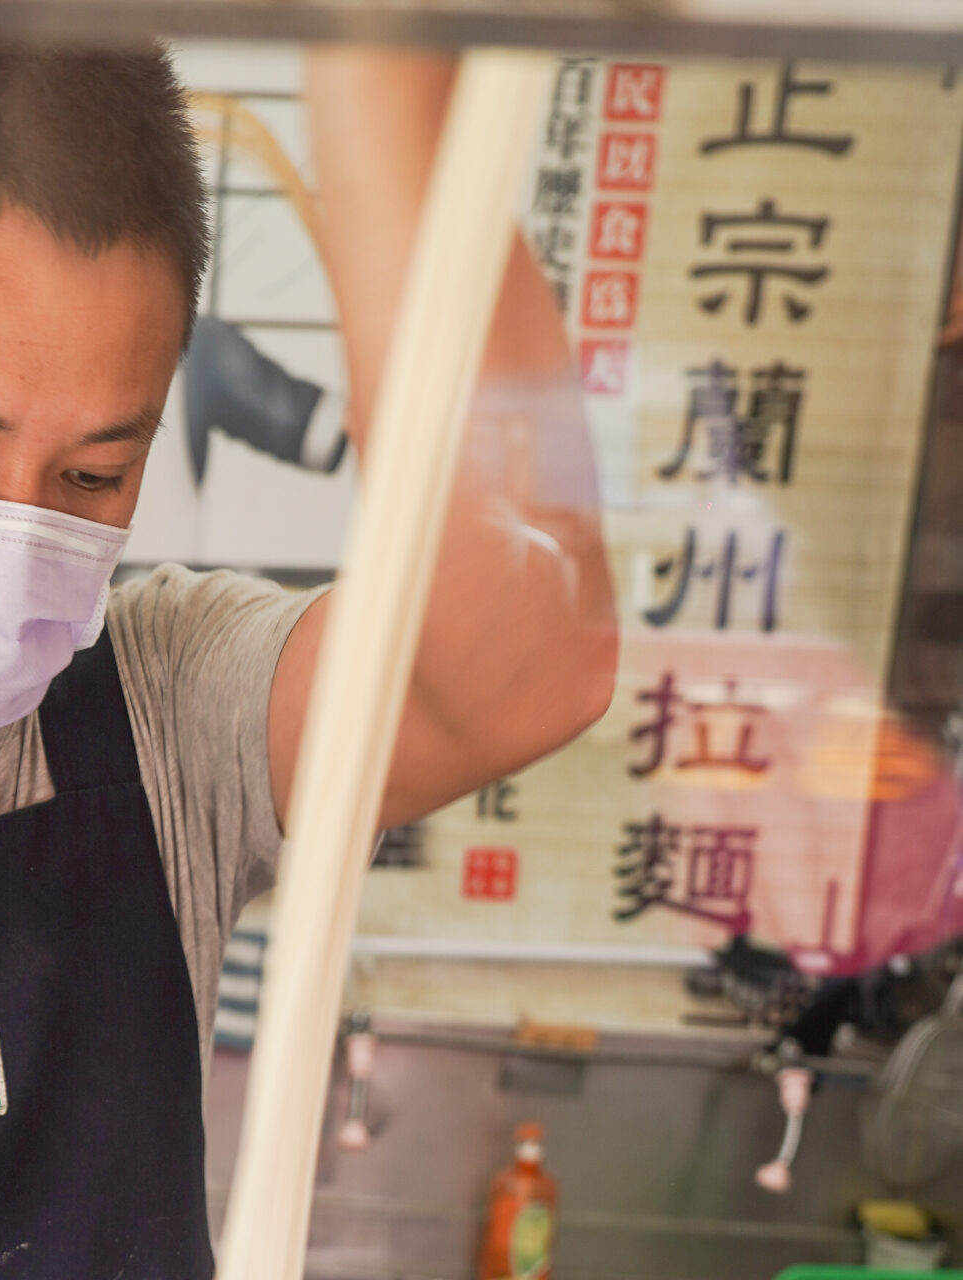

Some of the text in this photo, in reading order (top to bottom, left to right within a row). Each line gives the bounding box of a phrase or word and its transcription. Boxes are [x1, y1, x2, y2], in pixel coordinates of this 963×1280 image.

[612, 58, 855, 934] 正宗蘭州拉麵
